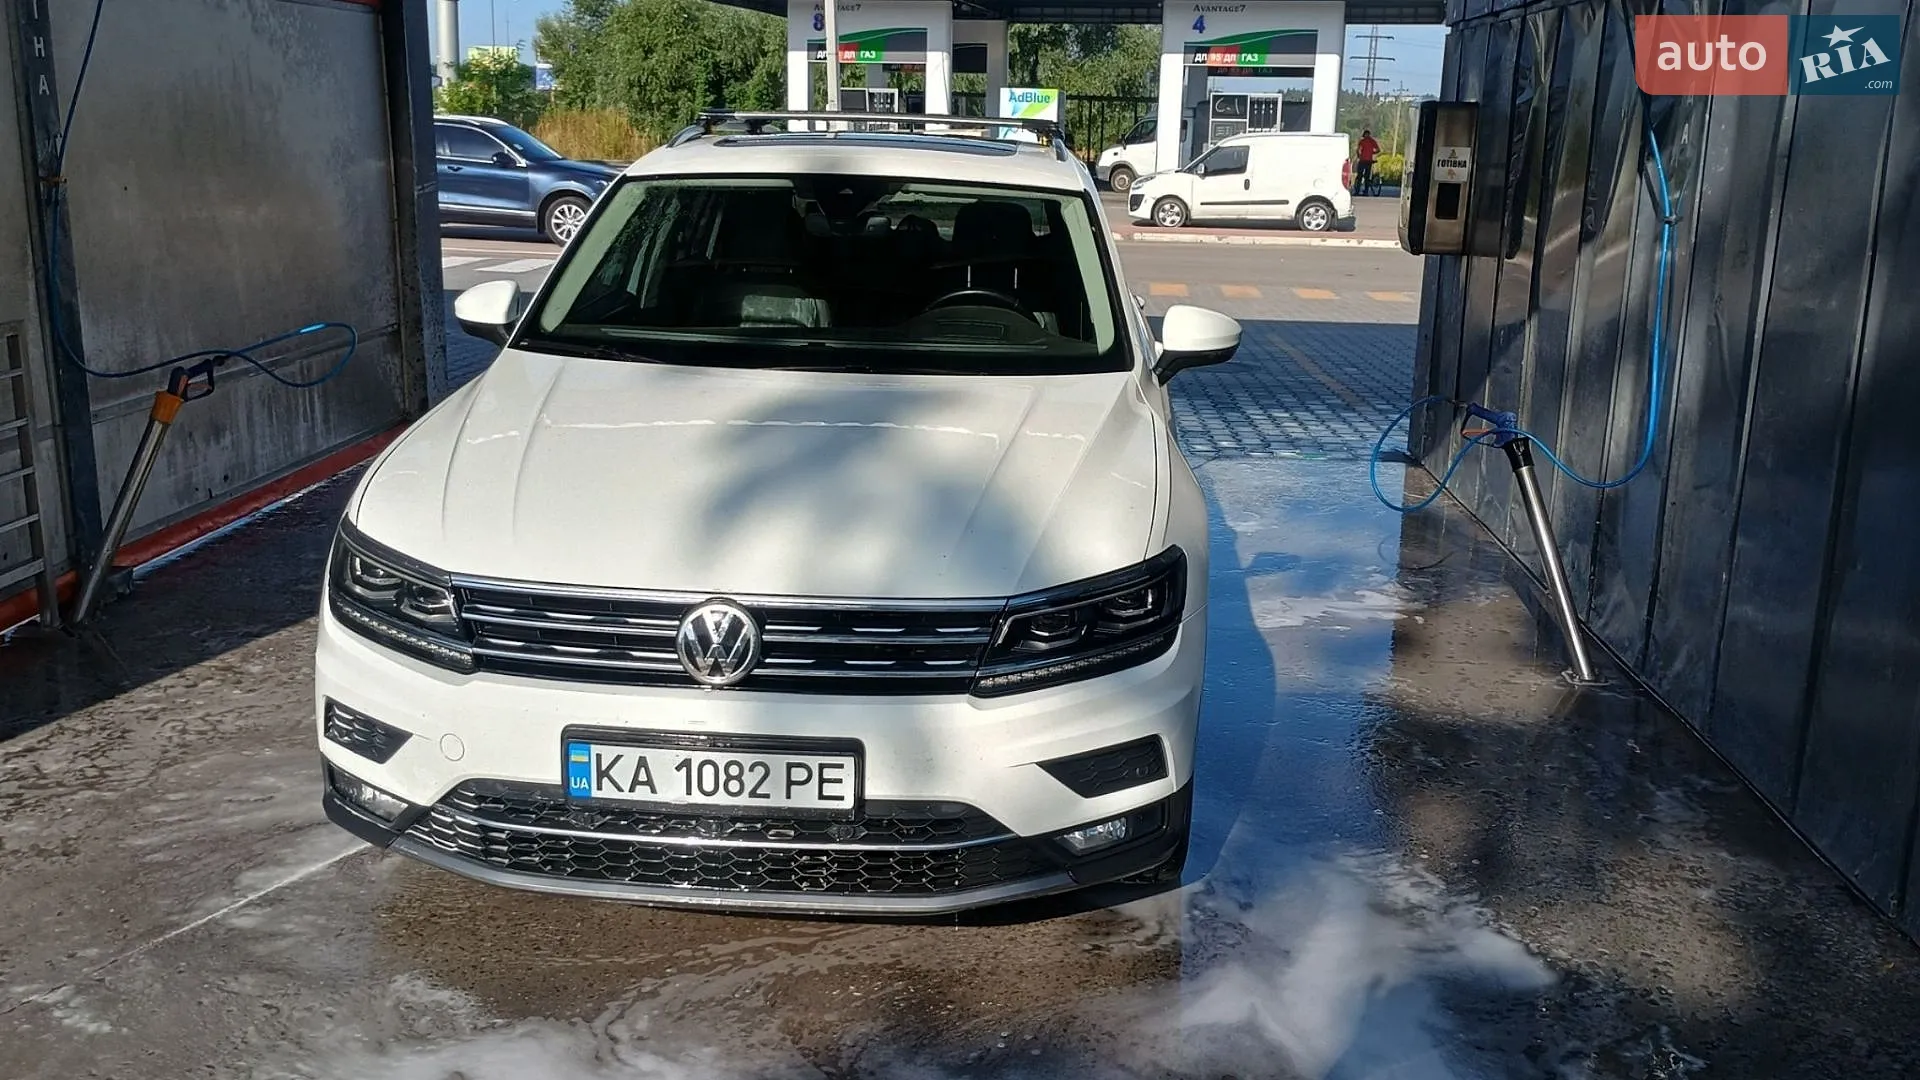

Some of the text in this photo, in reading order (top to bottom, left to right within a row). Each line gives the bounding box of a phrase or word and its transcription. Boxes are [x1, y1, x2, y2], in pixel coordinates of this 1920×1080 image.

[813, 13, 825, 31] 8
[1192, 15, 1206, 34] 4
[860, 50, 876, 59] ГАЗ
[1194, 53, 1208, 63] ДП
[1223, 53, 1236, 63] ДП
[1241, 53, 1259, 62] ГАЗ
[1008, 90, 1051, 103] AdBlue
[1437, 159, 1467, 168] ГОТІВКА
[570, 752, 846, 801] UA KA 1082 PE
